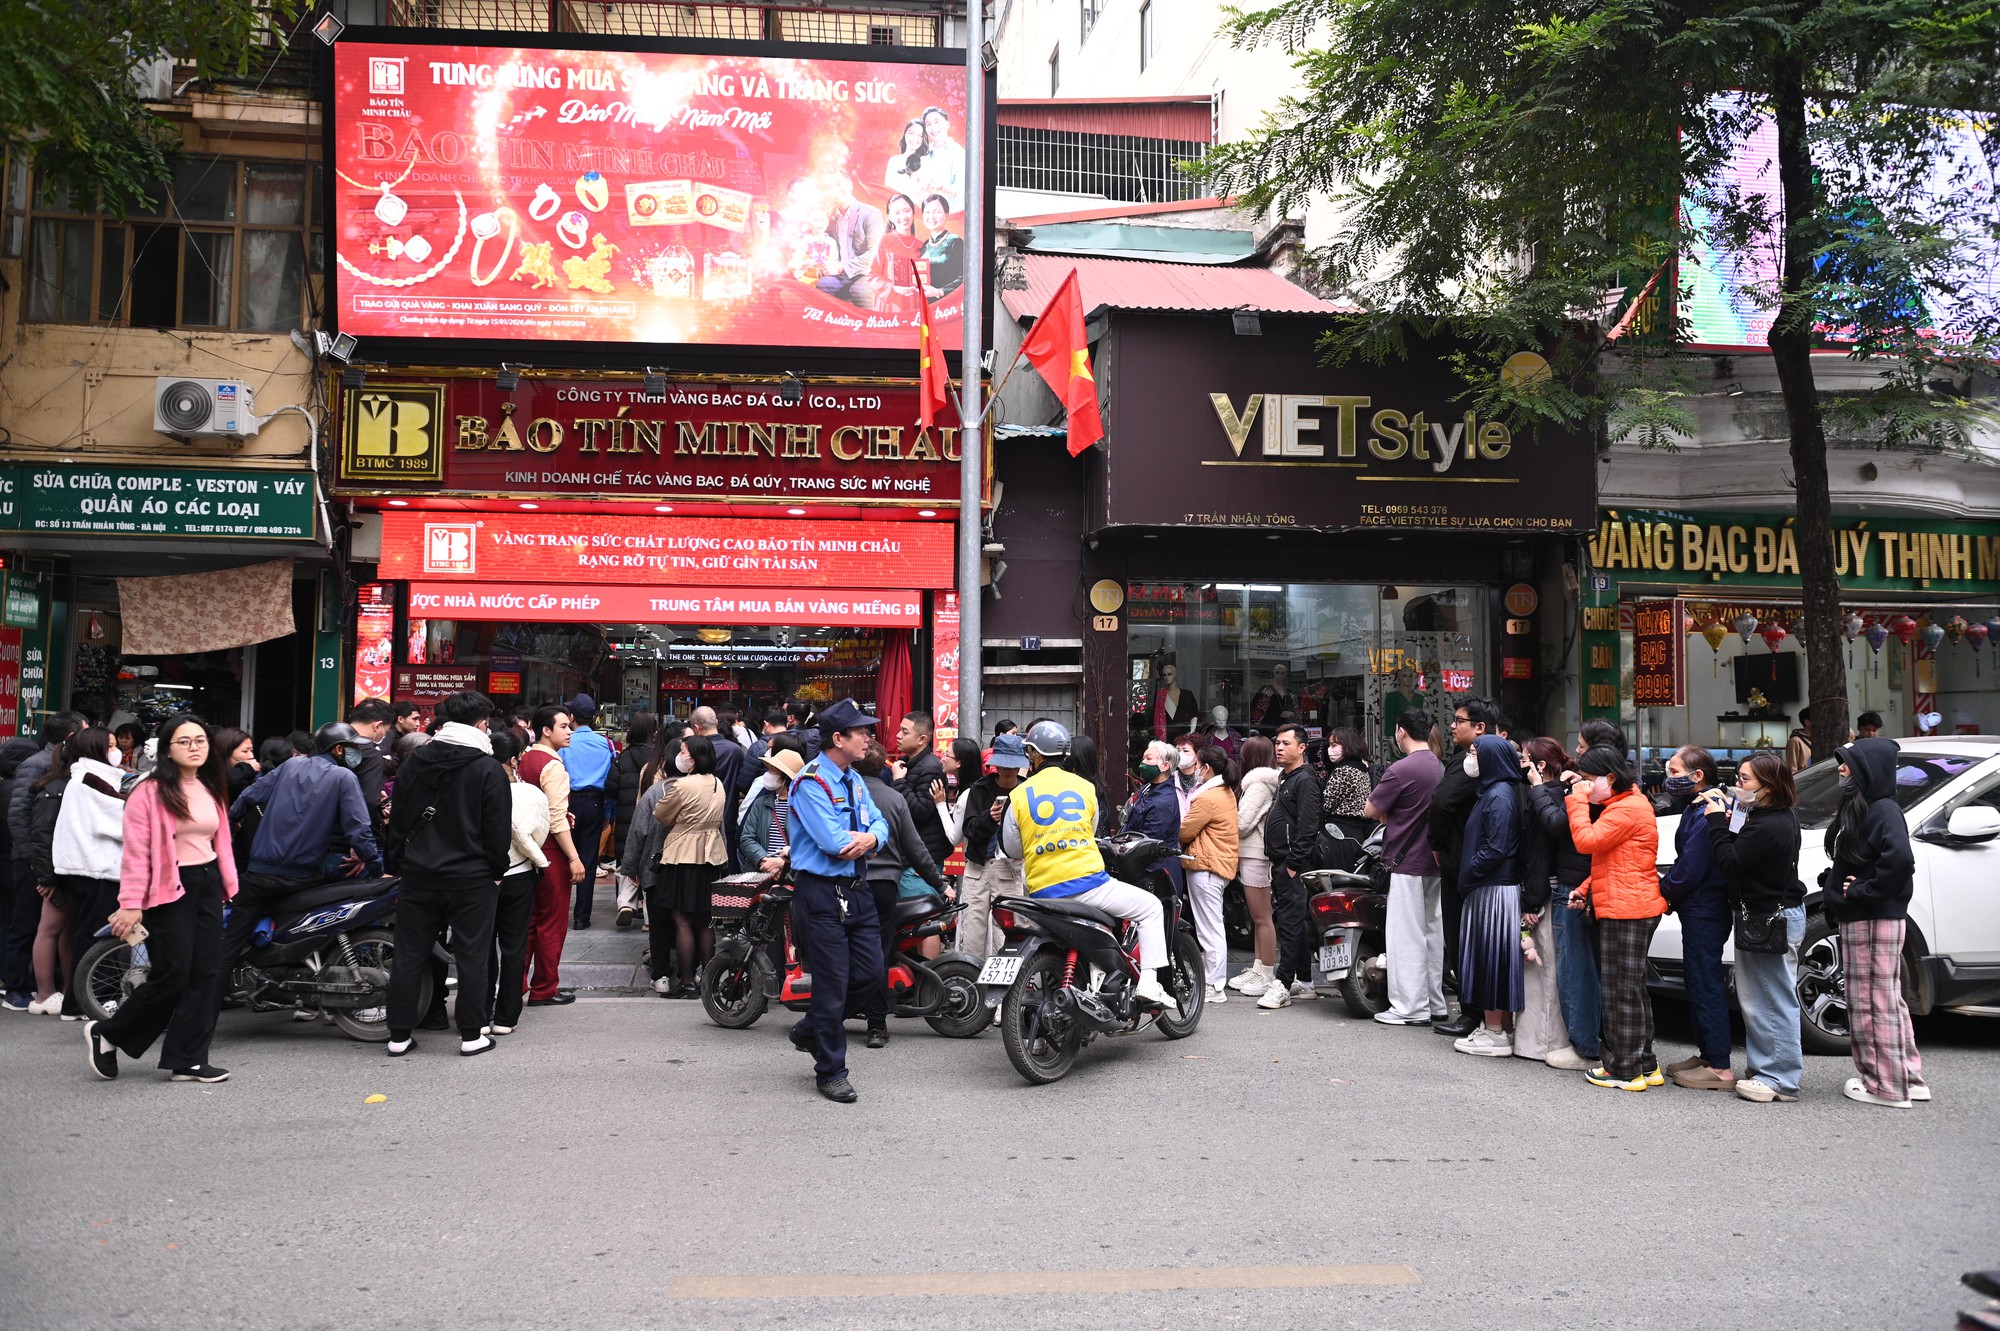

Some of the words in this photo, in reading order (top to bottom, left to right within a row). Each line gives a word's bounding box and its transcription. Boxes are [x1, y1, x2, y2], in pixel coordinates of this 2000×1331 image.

[566, 68, 616, 92] MUA
[740, 72, 771, 98] VÀ
[854, 76, 896, 104] SỨC
[369, 96, 385, 107] BẢO
[389, 97, 405, 107] TÍN
[361, 108, 386, 117] MINH
[387, 107, 412, 118] CHÂU
[557, 99, 606, 124] Đón
[679, 104, 724, 131] Năm
[724, 106, 773, 134] Mới
[411, 172, 456, 183] DOANH
[360, 300, 384, 308] TRAO
[401, 300, 420, 310] QUÀ
[420, 300, 446, 310] VÀNG
[452, 302, 473, 310] KHAI
[474, 301, 498, 311] XUÂN
[499, 303, 523, 311] SANG
[524, 302, 542, 312] QUÝ
[548, 303, 568, 312] ĐÓN
[569, 303, 585, 313] TẾT
[399, 316, 424, 325] Chương
[474, 318, 490, 327] ngày
[537, 319, 552, 328] ngày
[802, 306, 823, 321] Tết
[824, 311, 863, 332] trưởng
[866, 314, 899, 329] thành
[934, 305, 958, 320] trọn
[556, 387, 600, 404] CÔNG
[604, 391, 623, 404] TY
[627, 391, 667, 405] TNHH
[670, 389, 709, 405] VÀNG
[711, 393, 742, 408] BẠC
[746, 392, 768, 407] ĐÁ
[808, 394, 846, 412] (CO.,
[849, 396, 881, 411] LTD)
[455, 401, 565, 454] BẢO
[573, 405, 667, 455] TÍN
[674, 420, 823, 459] MINH
[830, 416, 962, 462] CHÂU
[356, 457, 395, 469] BTMC
[399, 458, 428, 469] 1989
[33, 470, 65, 488] SỬA
[69, 472, 112, 490] CHỮA
[117, 476, 182, 492] COMPLE
[196, 478, 258, 494] VESTON
[273, 477, 305, 495] VÁY
[505, 471, 537, 484] KINH
[541, 472, 591, 485] DOANH
[593, 470, 621, 486] CHẾ
[626, 472, 652, 486] TÁC
[656, 471, 693, 487] VÀNG
[696, 475, 724, 490] BẠC
[730, 474, 750, 488] ĐÁ
[790, 477, 836, 490] TRANG
[840, 475, 868, 491] SỨC
[871, 476, 892, 491] MỸ
[894, 477, 931, 494] NGHỆ
[80, 493, 133, 515] QUẦN
[141, 496, 169, 515] ÁO
[174, 497, 211, 516] CÁC
[216, 502, 260, 520] LOẠI
[1361, 504, 1384, 514] TEL:
[1385, 505, 1409, 514] 0969
[1410, 505, 1429, 515] 543
[1431, 505, 1448, 515] 376
[1183, 513, 1194, 523] 17
[1231, 512, 1261, 524] NHÂN
[1266, 512, 1296, 524] TÔNG
[1450, 516, 1466, 527] SỰ
[1468, 517, 1491, 528] LỰA
[1493, 517, 1523, 528] CHỌN
[1525, 518, 1548, 527] CHO
[35, 519, 49, 528] ĐC:
[49, 517, 61, 529] SỐ
[62, 521, 70, 529] 13
[92, 520, 115, 530] NHÂN
[115, 520, 136, 531] TÔNG
[141, 521, 152, 532] HÀ
[152, 522, 166, 533] NỘI
[215, 525, 233, 533] 6174
[234, 525, 248, 533] 897
[283, 526, 301, 535] 7314
[492, 530, 535, 546] VÀNG
[538, 534, 588, 547] TRANG
[592, 533, 621, 548] SỨC
[624, 534, 666, 549] CHẤT
[668, 536, 720, 552] LƯỢNG
[723, 538, 754, 551] CAO
[757, 537, 788, 551] BẢO
[790, 537, 816, 552] TÍN
[818, 540, 858, 552] MINH
[860, 538, 901, 553] CHÂU
[1588, 509, 1675, 571] VÀNG
[1682, 525, 1749, 582] BẠC
[1753, 517, 1801, 575] ĐÁ
[1878, 531, 1972, 588] THỊNH
[578, 554, 620, 569] RẠNG
[623, 553, 645, 568] RỠ
[646, 555, 668, 570] TỰ
[670, 556, 700, 570] TIN,
[702, 555, 731, 569] GIỮ
[733, 556, 759, 569] GÌN
[762, 555, 787, 570] TÀI
[789, 556, 818, 570] SẢN
[10, 577, 23, 588] ĐỨC
[1594, 578, 1606, 589] 19
[444, 592, 476, 608] NHÀ
[480, 593, 525, 609] NƯỚC
[528, 594, 558, 609] CẤP
[561, 594, 601, 610] PHÉP
[649, 599, 700, 612] TRUNG
[703, 597, 735, 612] TÂM
[738, 600, 771, 613] MUA
[775, 598, 805, 614] BÁN
[808, 600, 849, 615] VÀNG
[852, 600, 901, 616] MIẾNG
[20, 603, 33, 615] HIỆU
[1099, 618, 1114, 629] 17
[1511, 621, 1526, 632] 17
[1636, 607, 1671, 637] VÀNG
[1025, 637, 1037, 649] 17
[26, 647, 43, 662] SỬA
[669, 653, 682, 661] THE
[701, 654, 722, 662] TRANG
[723, 653, 736, 662] SỨC
[737, 654, 749, 662] KIM
[750, 654, 773, 662] CƯƠNG
[774, 654, 787, 662] CAO
[788, 654, 801, 662] CẤP
[1640, 640, 1667, 671] BẠC
[320, 657, 335, 669] 13
[22, 665, 44, 680] CHỮA
[1636, 674, 1672, 699] 9999
[1025, 785, 1086, 827] be
[988, 957, 1017, 970] 29-Y1
